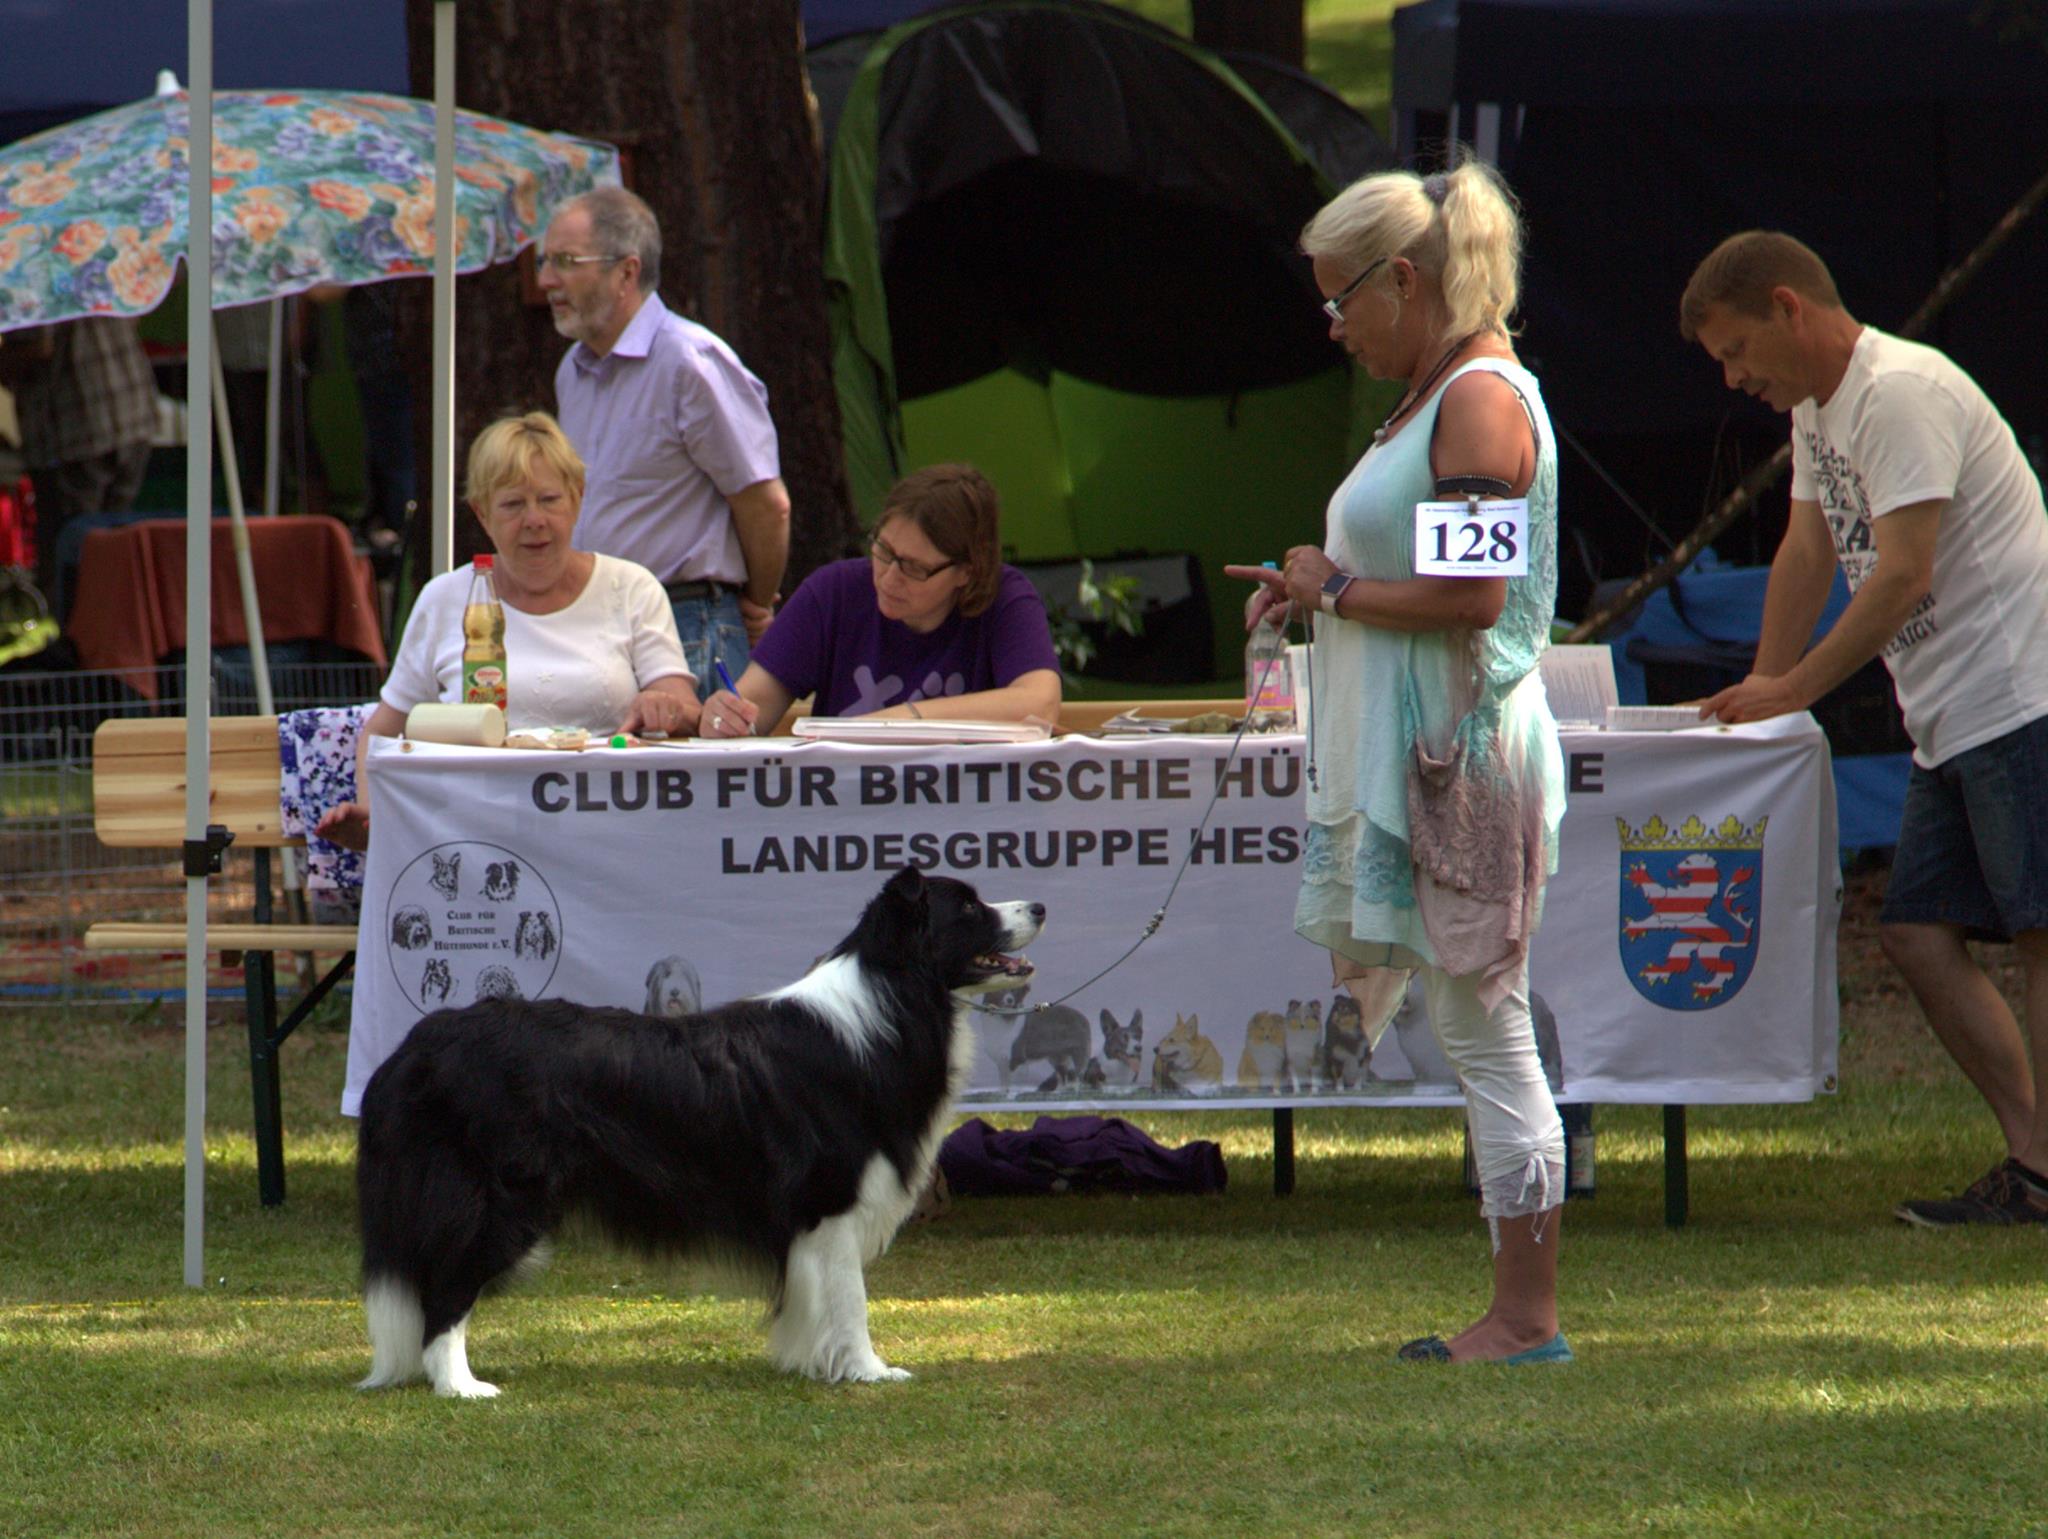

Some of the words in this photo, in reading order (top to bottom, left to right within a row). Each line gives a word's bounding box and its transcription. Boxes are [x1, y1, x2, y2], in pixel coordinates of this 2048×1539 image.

[1429, 520, 1518, 563] 128
[532, 769, 694, 813] CLUB
[717, 758, 839, 808] FÜR
[860, 758, 1192, 806] BRITISCHE
[721, 827, 1170, 874] LANDESGRUPPE
[1190, 825, 1305, 866] HES
